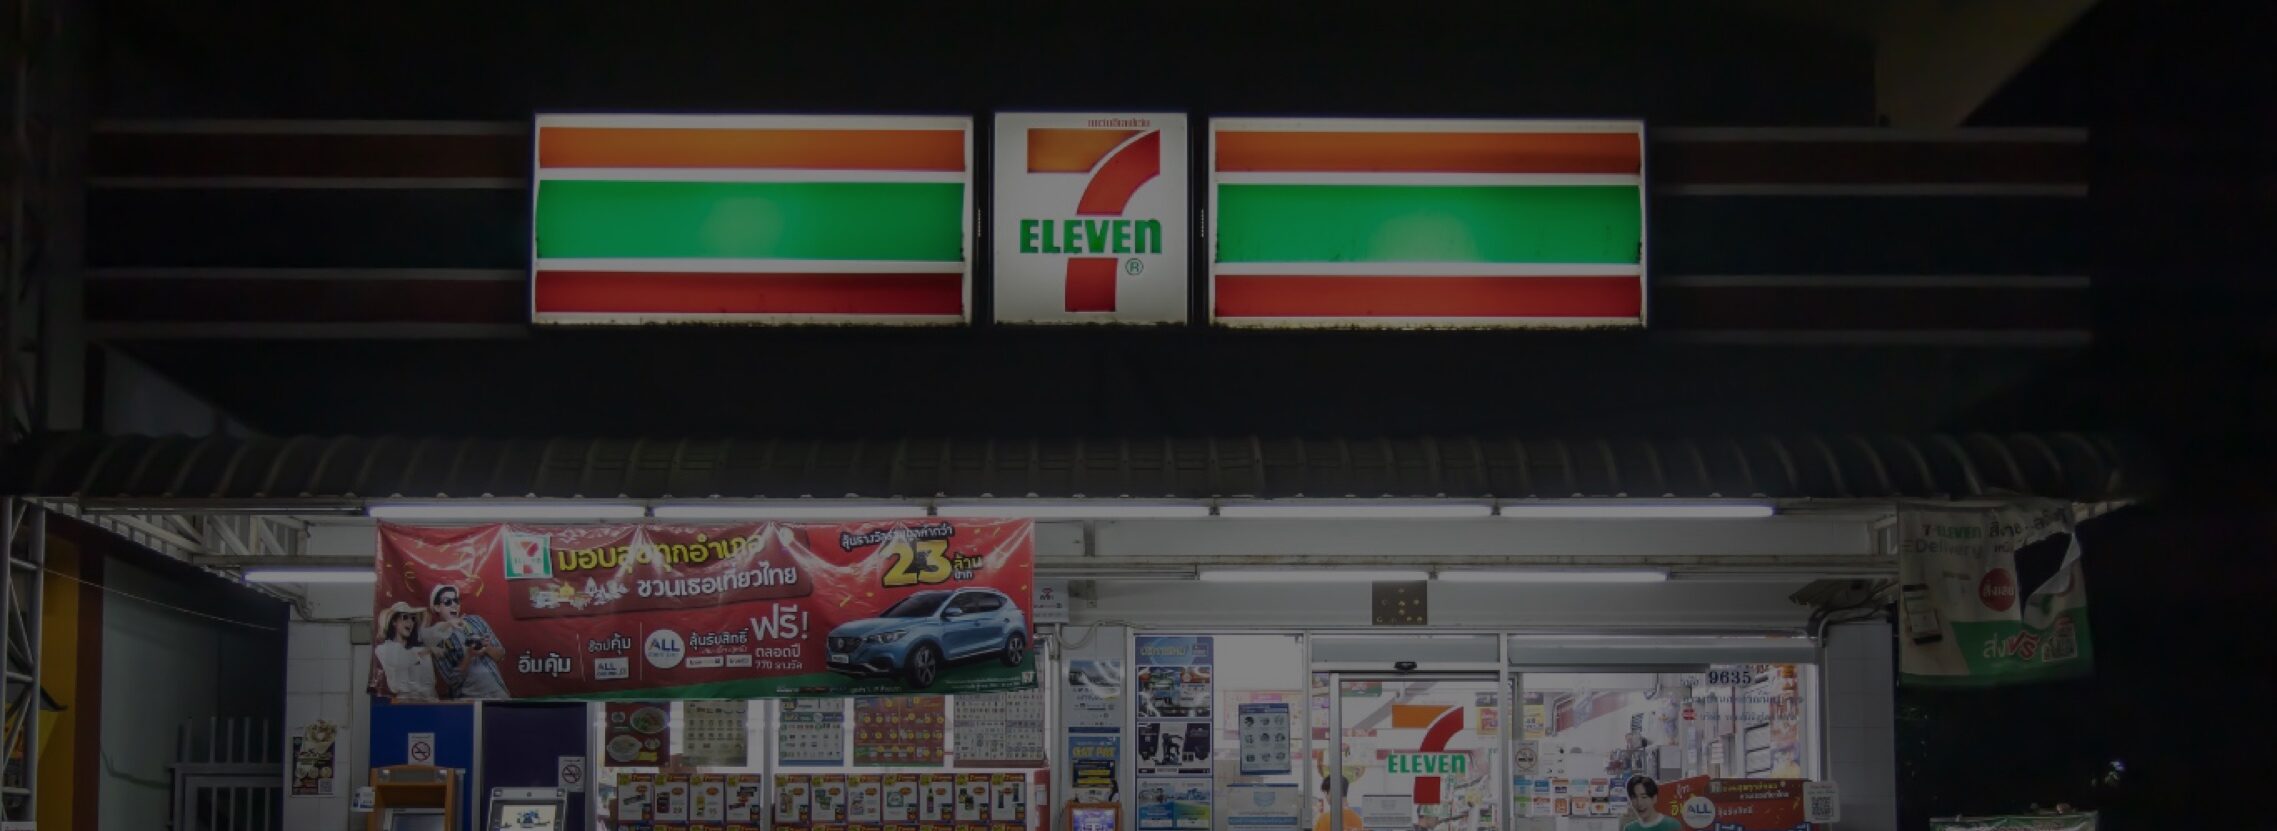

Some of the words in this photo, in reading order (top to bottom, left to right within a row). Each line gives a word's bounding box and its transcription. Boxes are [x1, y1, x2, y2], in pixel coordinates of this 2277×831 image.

[1027, 128, 1160, 312] 7
[880, 540, 952, 586] 23
[637, 560, 796, 598] ชวนเธอเที่ยวไทย
[648, 638, 681, 652] ALL
[754, 642, 801, 658] ตลอดปี
[1709, 671, 1752, 685] 9635
